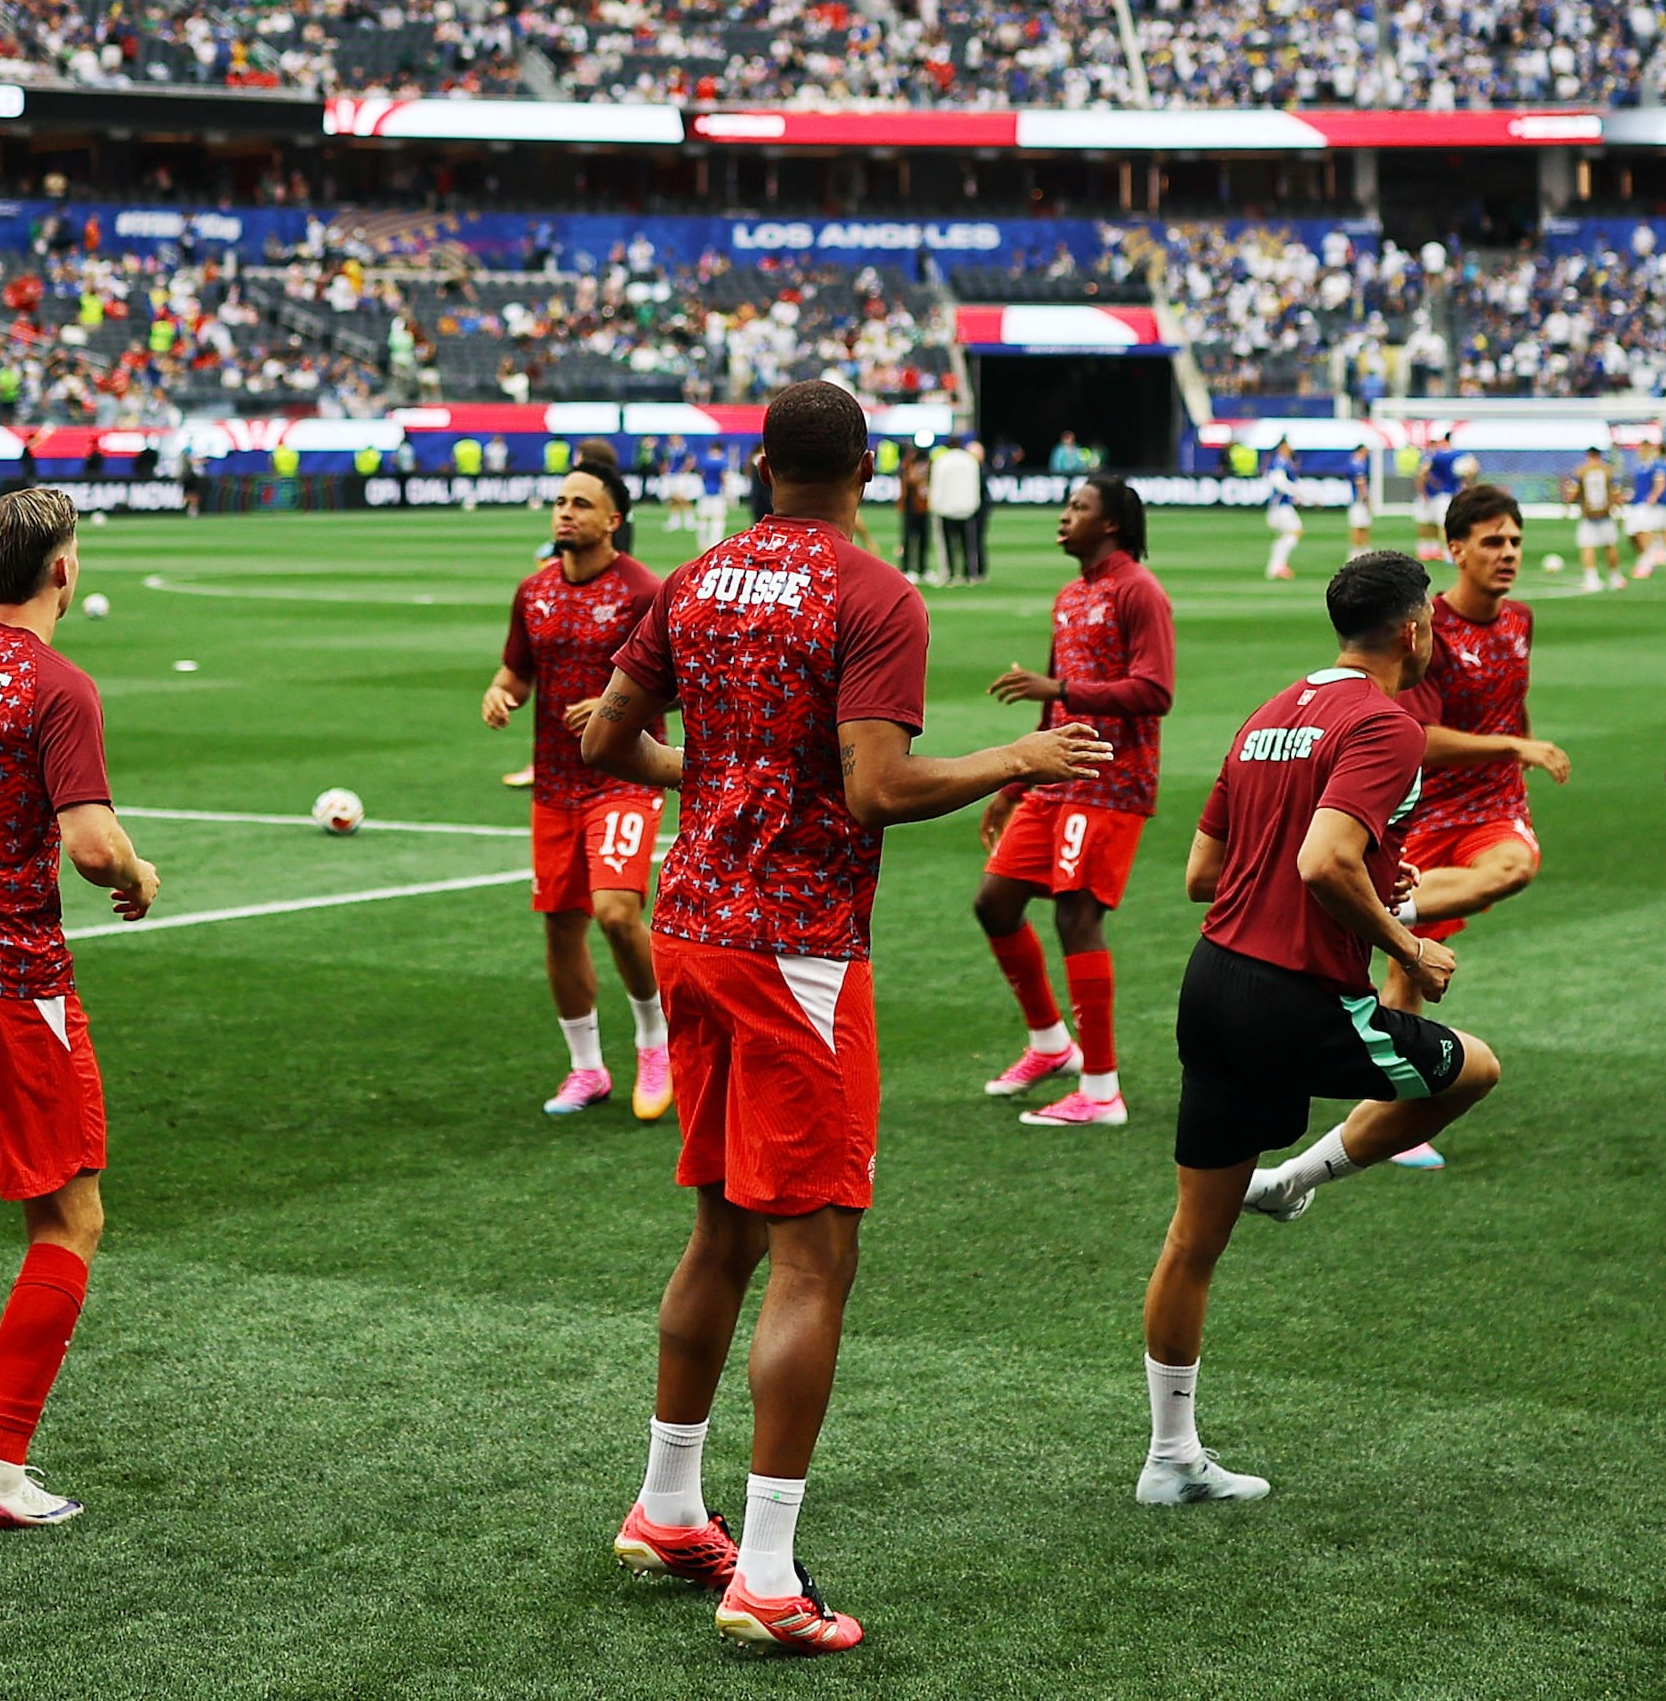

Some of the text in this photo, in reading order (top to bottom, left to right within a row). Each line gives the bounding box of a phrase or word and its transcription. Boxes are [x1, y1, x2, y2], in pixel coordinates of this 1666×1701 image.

[732, 222, 815, 249] LOS
[695, 566, 812, 611] SUISSE
[1239, 725, 1326, 762] SUISSE
[598, 810, 644, 857] 19
[1060, 813, 1088, 860] 9
